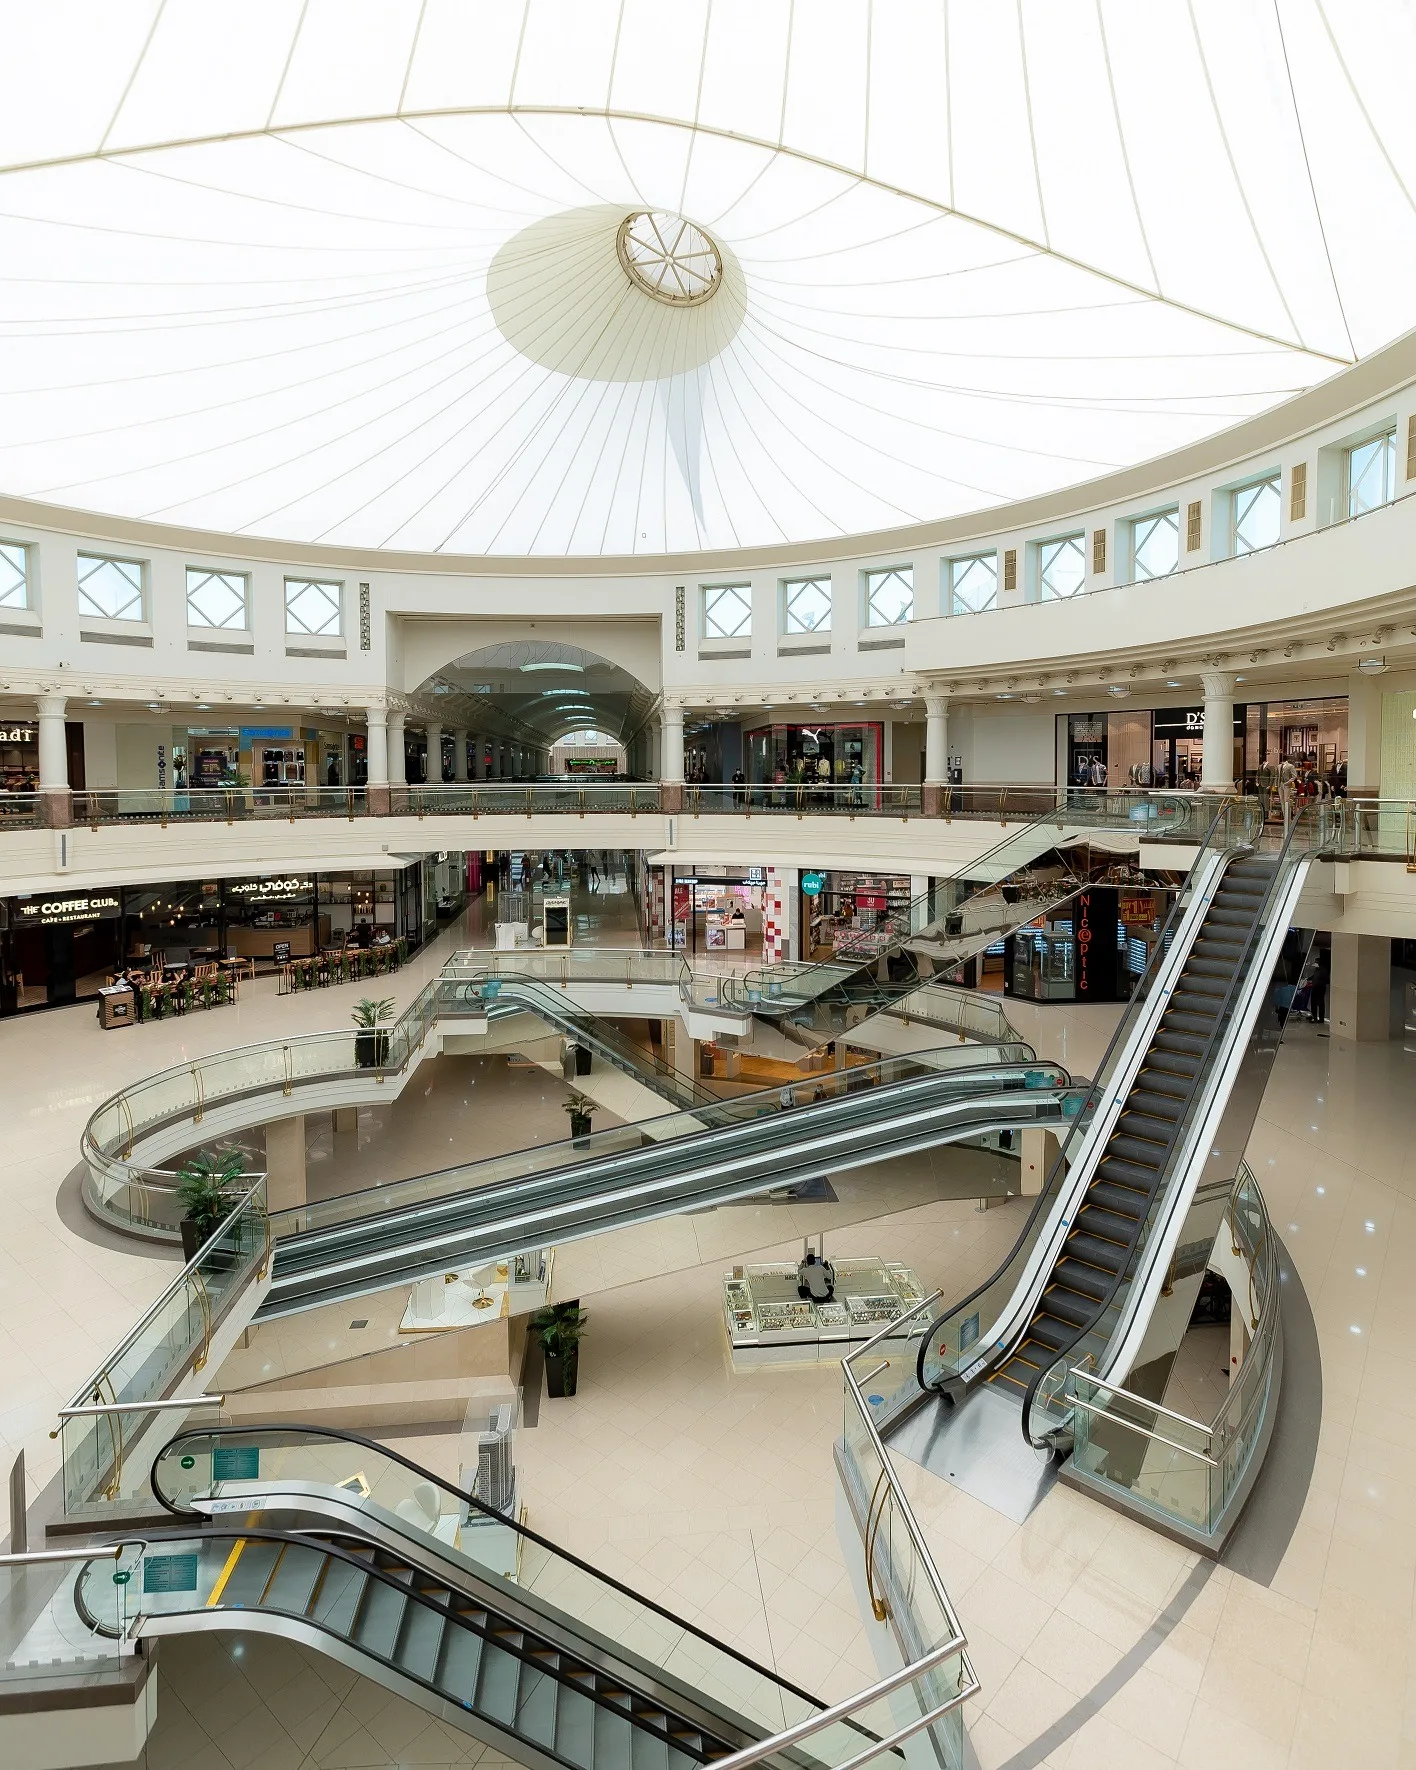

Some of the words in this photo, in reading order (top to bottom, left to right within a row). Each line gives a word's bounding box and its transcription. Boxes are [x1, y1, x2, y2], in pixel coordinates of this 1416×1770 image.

[803, 881, 820, 889] rubi
[20, 905, 41, 915] THE
[41, 899, 89, 914] COFFEE
[62, 912, 101, 922] RESTAURANT
